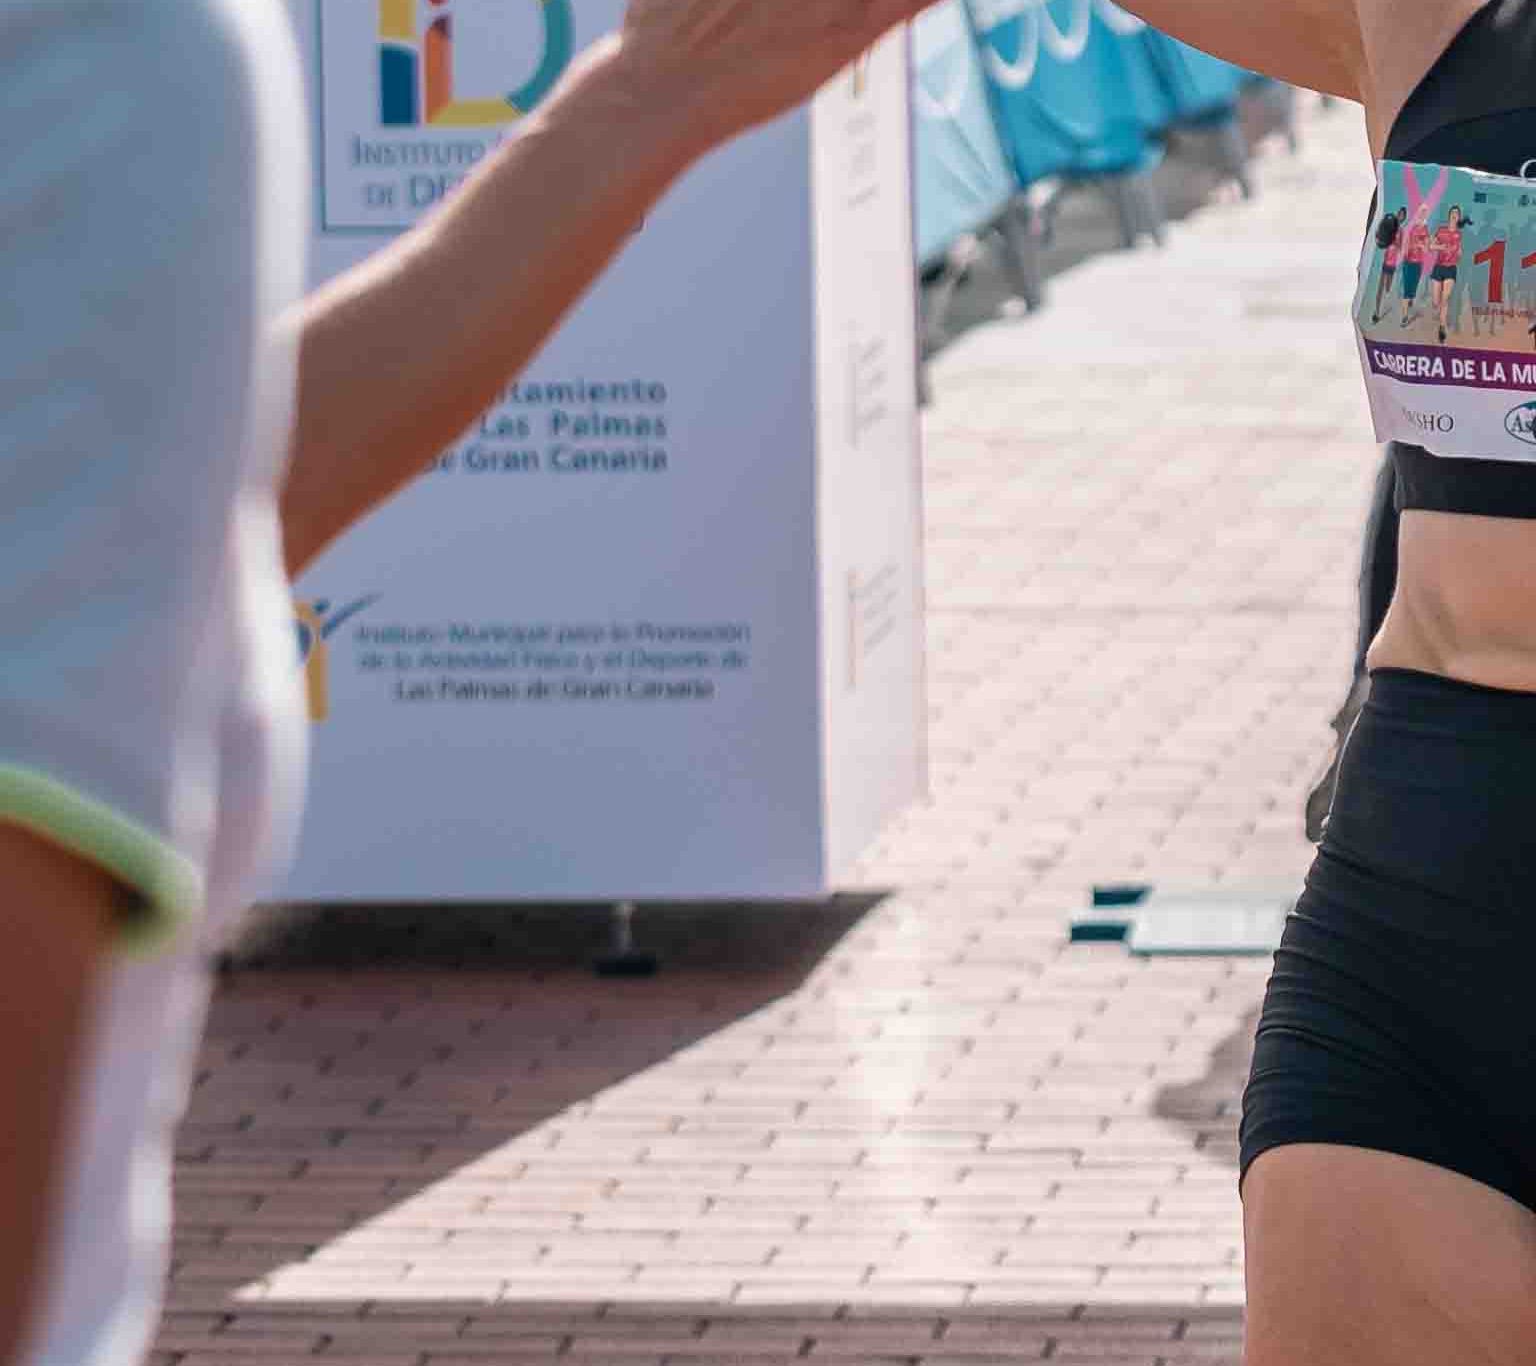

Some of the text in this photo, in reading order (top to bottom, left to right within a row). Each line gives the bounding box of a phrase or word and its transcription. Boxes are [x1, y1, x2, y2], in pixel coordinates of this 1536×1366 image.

[1372, 349, 1446, 379] CARRERA
[1450, 357, 1477, 381] DE
[1480, 360, 1506, 383] LA
[504, 375, 669, 404] tamiento
[550, 408, 669, 437] Palmas
[464, 442, 540, 470] Gran
[549, 442, 669, 470] Canaria
